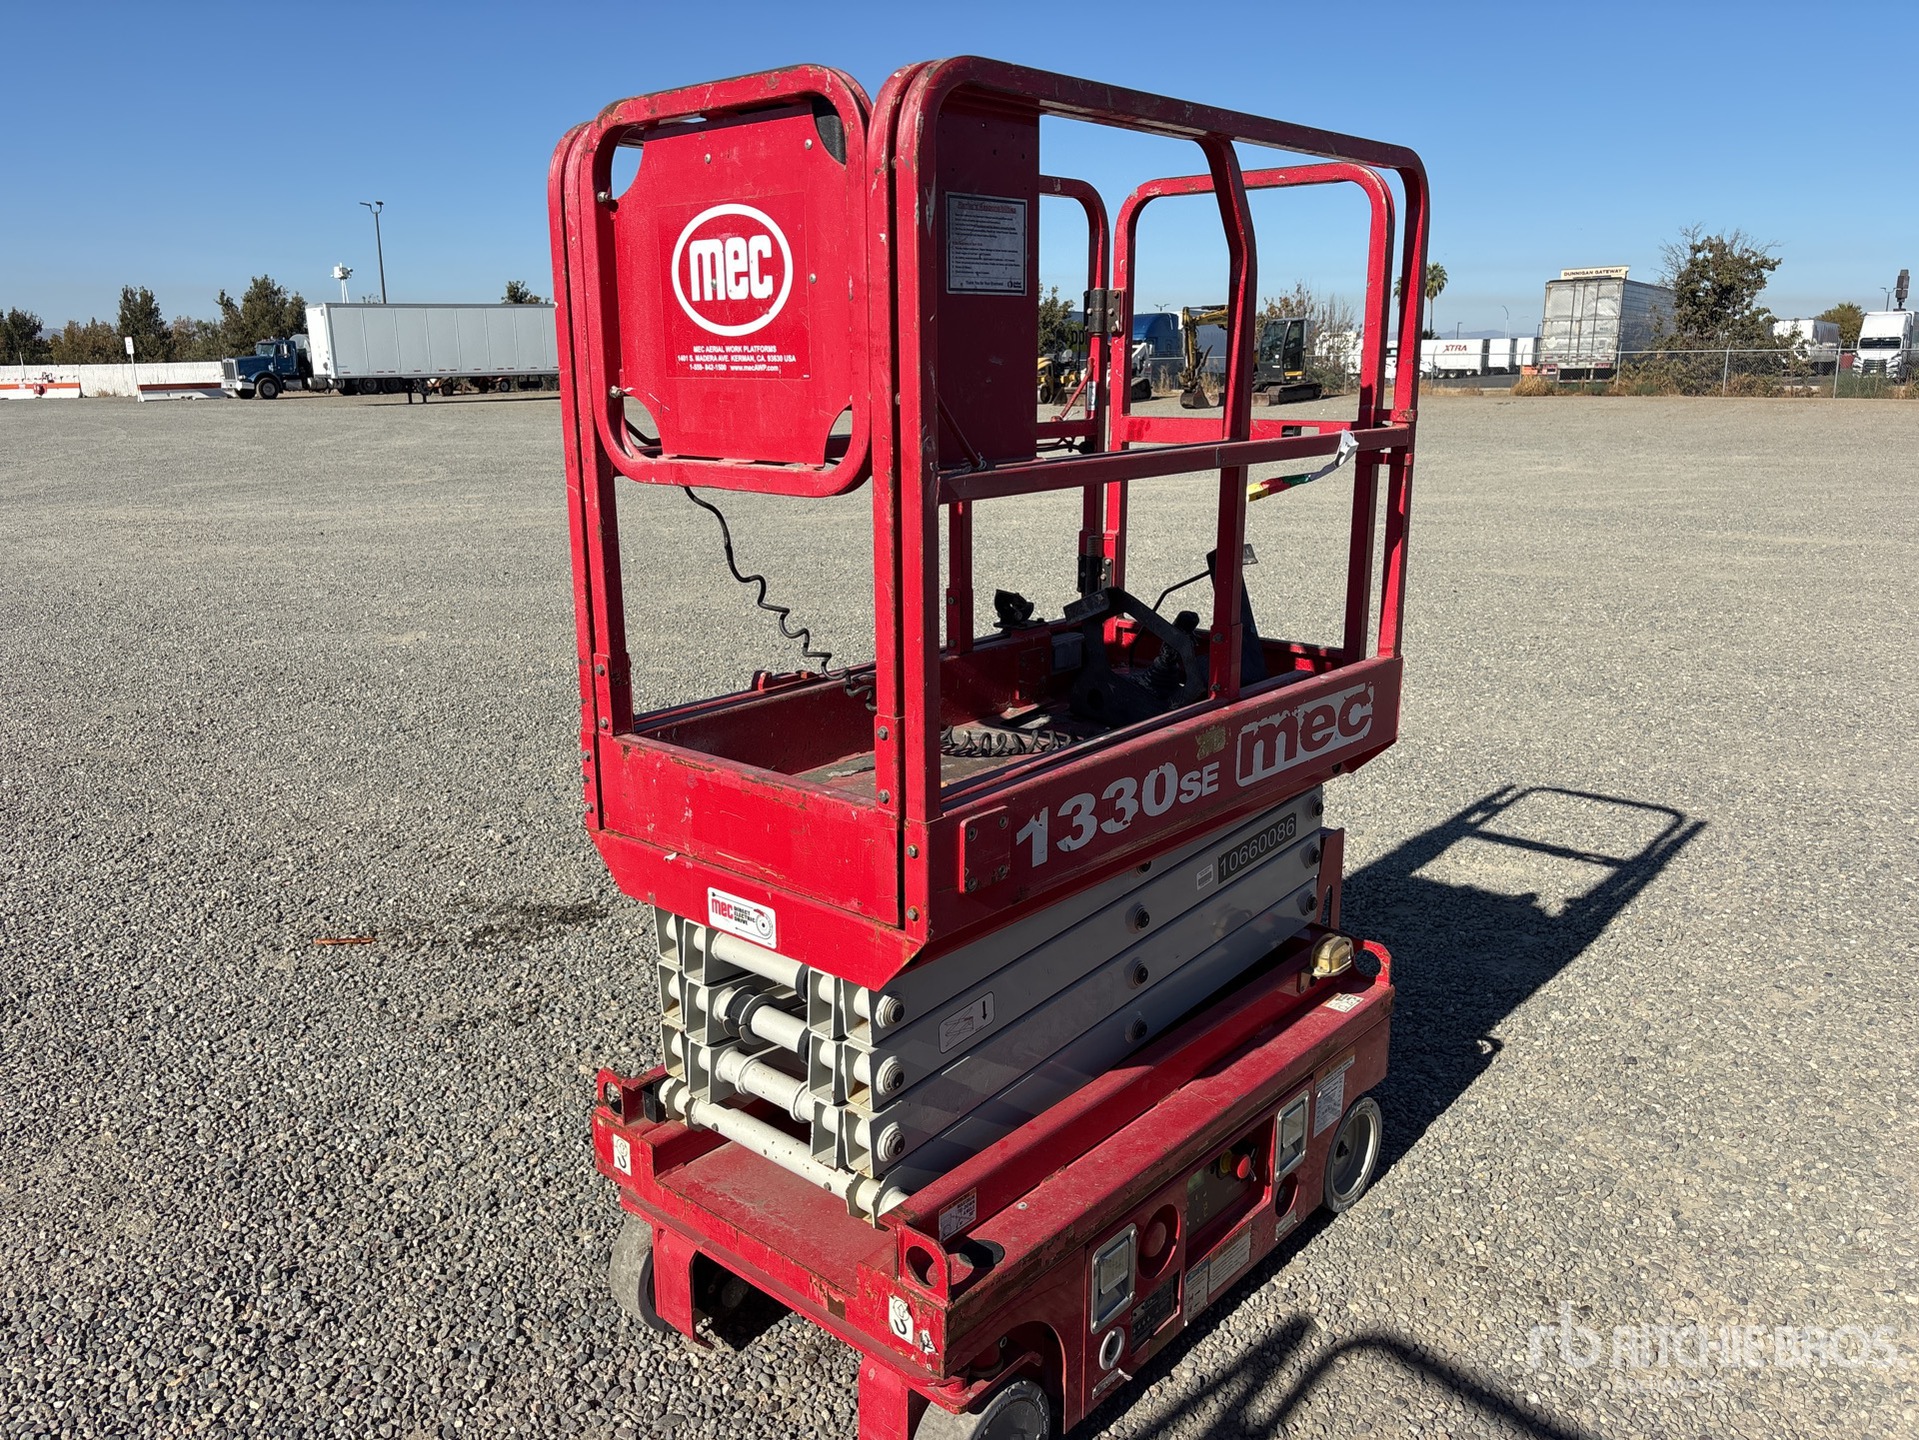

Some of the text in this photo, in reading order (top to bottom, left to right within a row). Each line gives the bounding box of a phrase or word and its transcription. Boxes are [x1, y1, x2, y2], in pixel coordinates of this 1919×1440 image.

[689, 234, 773, 302] mec
[693, 345, 777, 353] MEC AERIAL WORK PLATFORMS
[783, 355, 797, 363] USA
[1442, 344, 1468, 354] XTRA
[1239, 686, 1373, 780] mec
[1220, 817, 1295, 876] 10660086
[711, 898, 734, 919] mec
